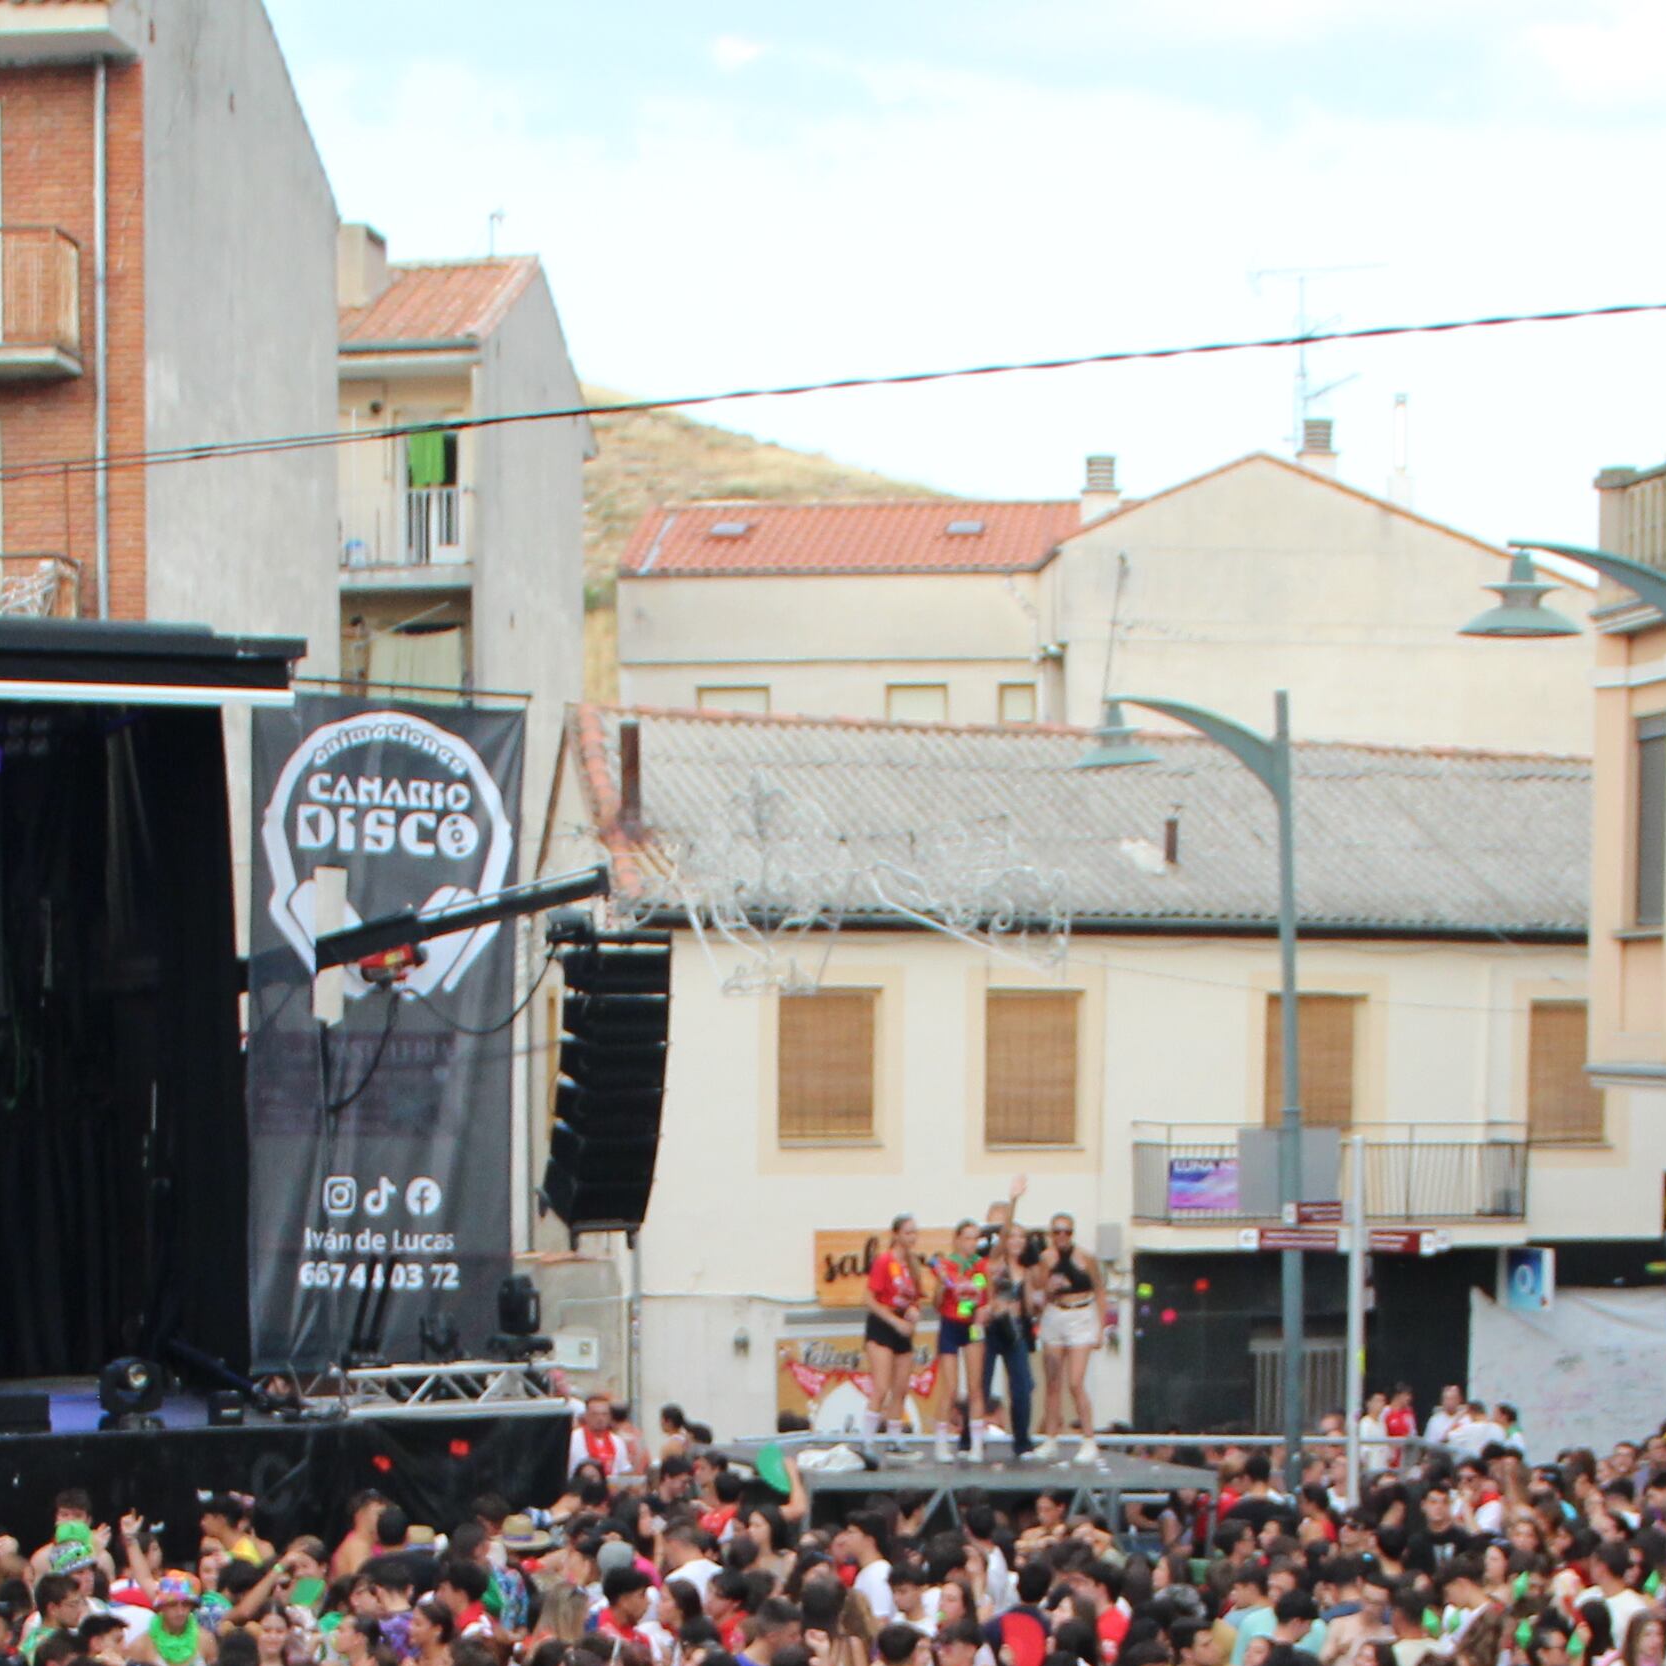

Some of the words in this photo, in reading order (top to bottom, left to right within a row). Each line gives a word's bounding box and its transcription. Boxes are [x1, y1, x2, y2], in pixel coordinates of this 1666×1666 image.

[313, 723, 471, 776] animaciones
[307, 771, 472, 813] CANARIO
[296, 803, 480, 861] DISCO
[303, 1227, 352, 1251] Iván
[355, 1228, 388, 1252] de
[392, 1229, 456, 1252] Lucas
[299, 1261, 348, 1289] 667
[390, 1263, 425, 1291] 03
[430, 1262, 461, 1291] 72
